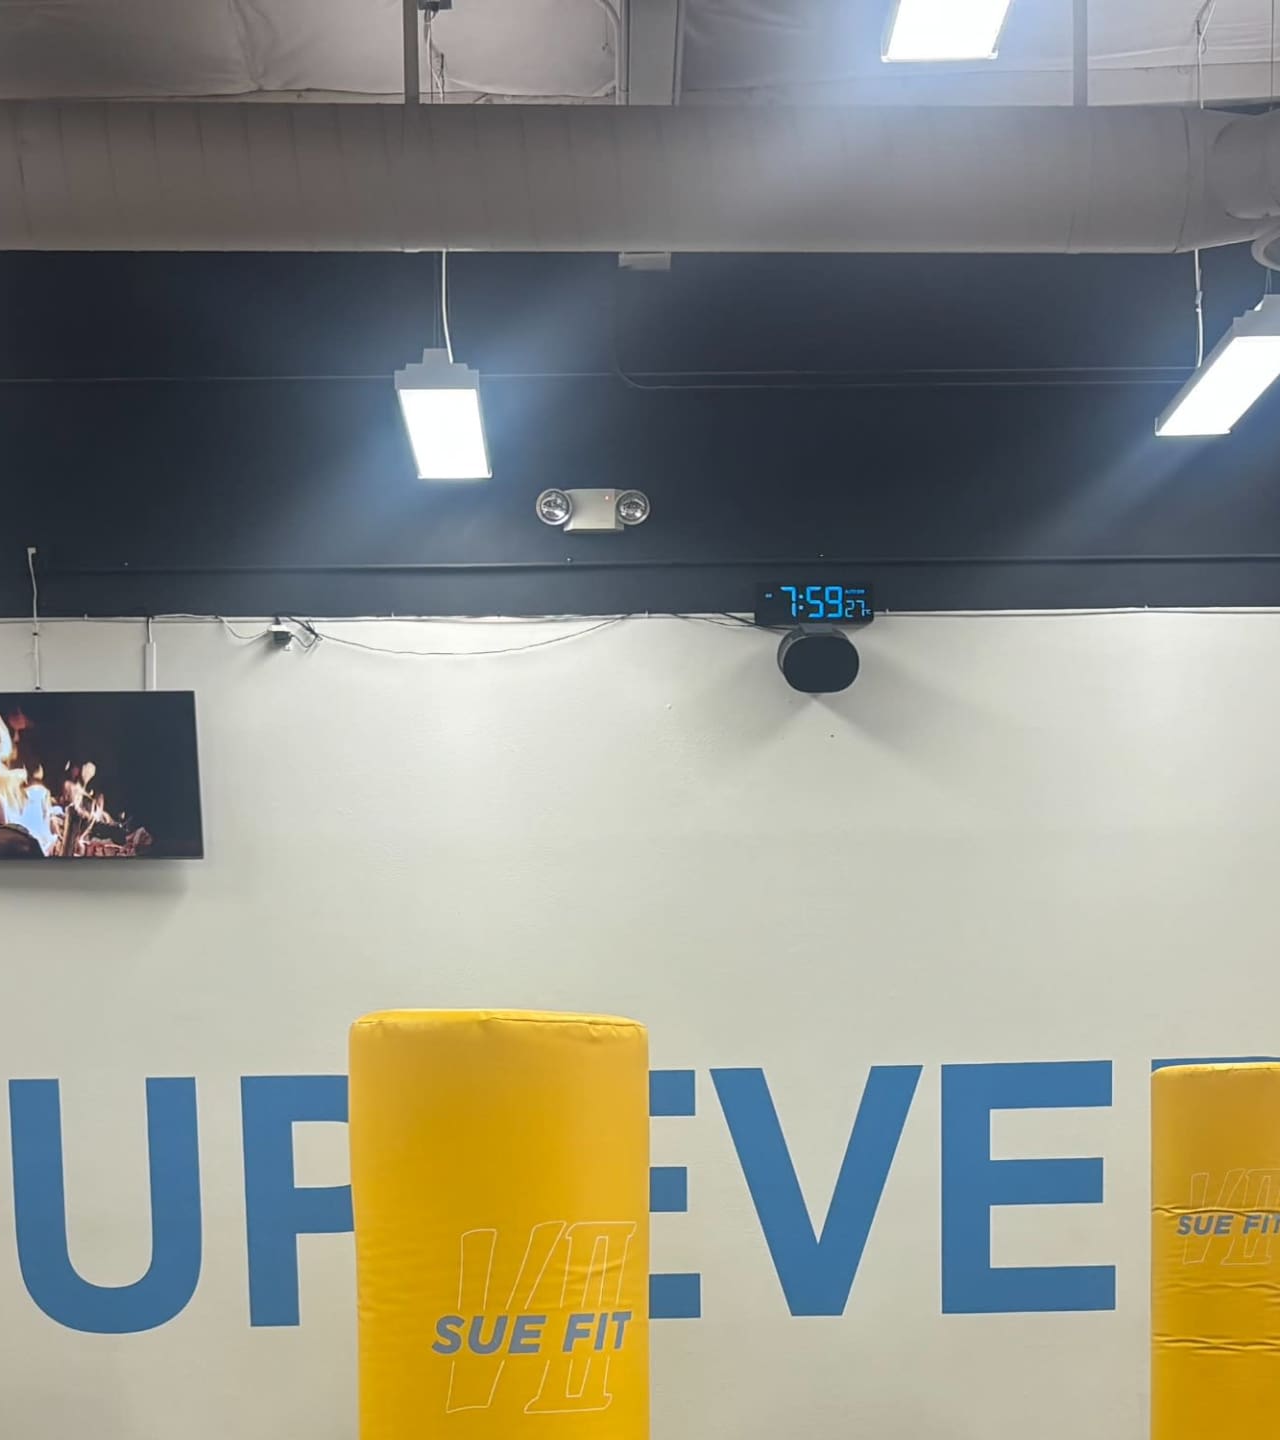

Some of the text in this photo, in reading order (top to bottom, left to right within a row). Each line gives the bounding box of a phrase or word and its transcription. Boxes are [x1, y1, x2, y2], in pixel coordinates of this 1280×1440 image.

[780, 586, 843, 618] 7:59
[1176, 1214, 1233, 1236] SUE
[431, 1310, 632, 1357] SUE FIT
